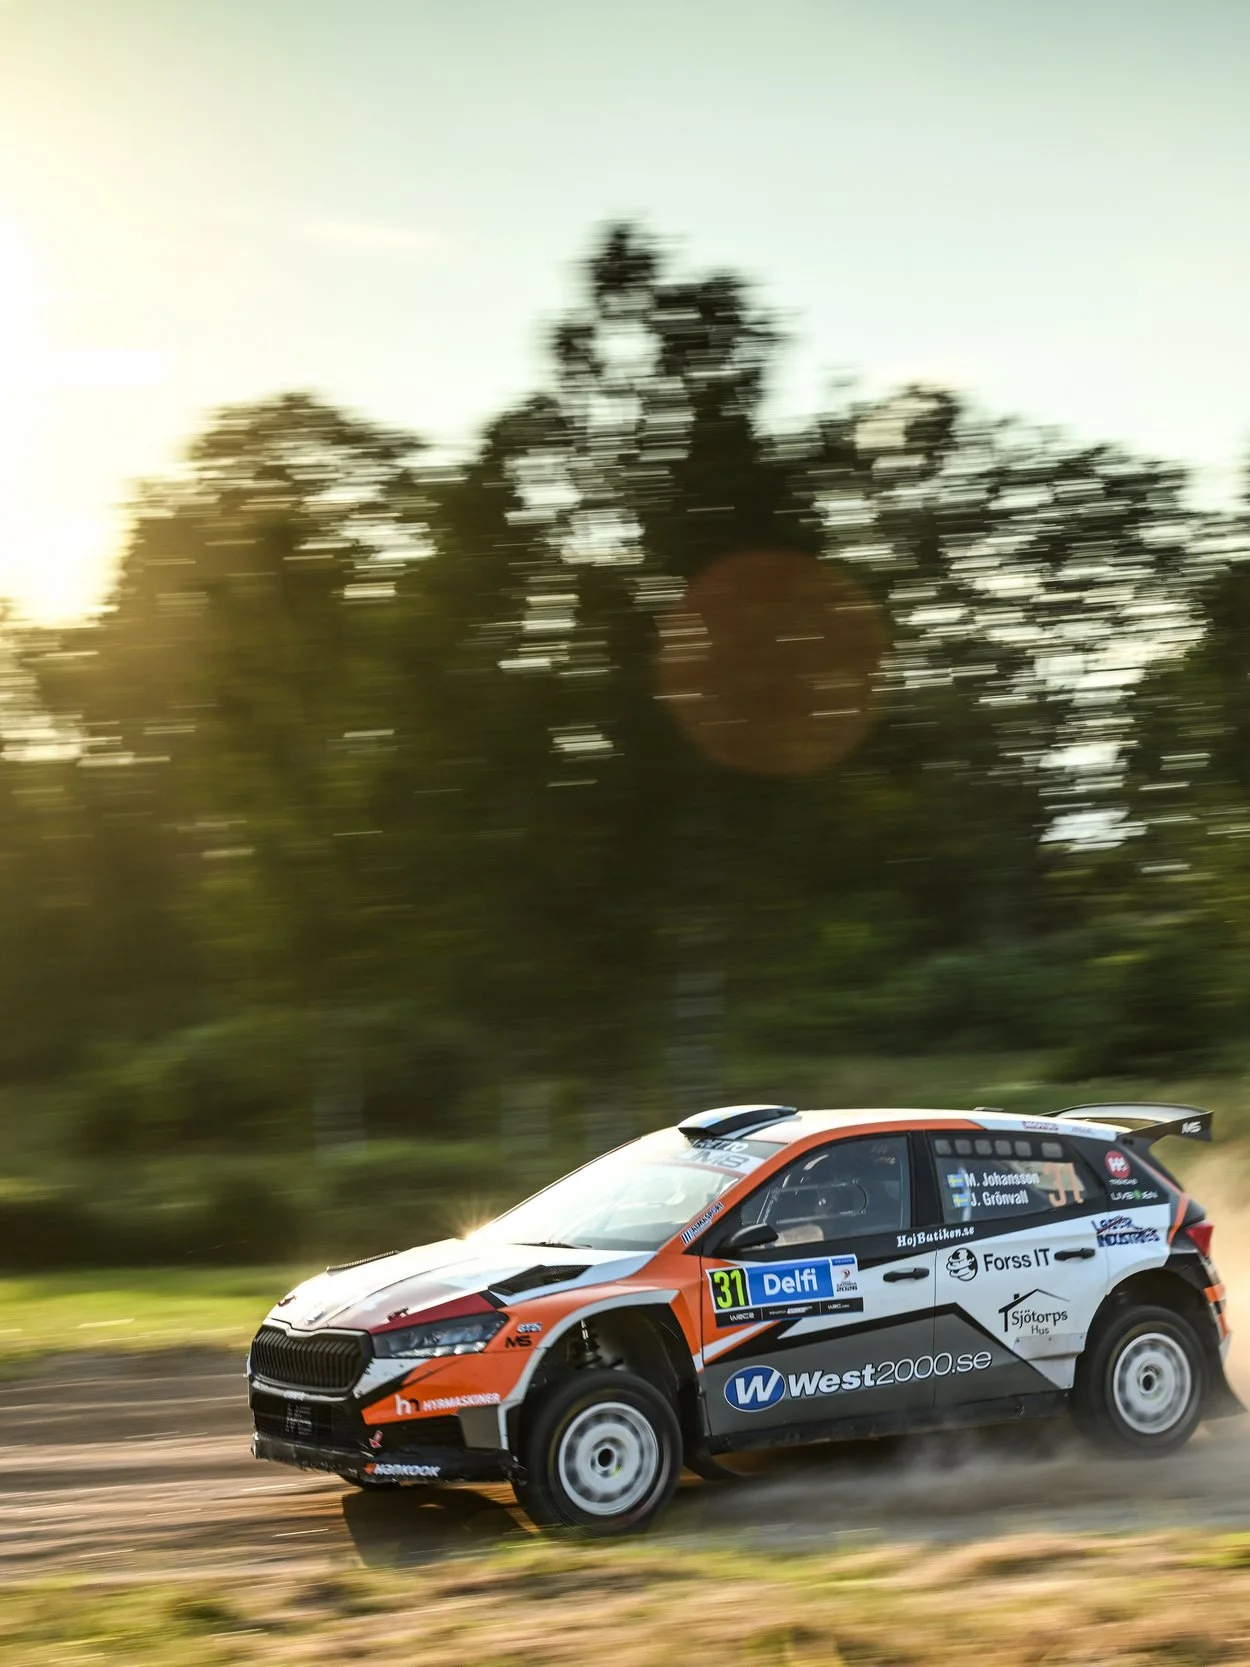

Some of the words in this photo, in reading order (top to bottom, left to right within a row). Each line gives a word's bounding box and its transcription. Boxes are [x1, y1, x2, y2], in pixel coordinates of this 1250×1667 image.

[964, 1173, 980, 1188] M.
[982, 1171, 1040, 1187] Johansson
[1043, 1161, 1085, 1207] 31
[970, 1194, 981, 1207] J.
[982, 1189, 1029, 1206] Grönvall
[896, 1226, 975, 1248] HojButiken.se
[983, 1251, 1032, 1273] Forss
[1033, 1248, 1051, 1266] IT
[714, 1268, 746, 1309] 31
[763, 1267, 819, 1296] Delfi
[1011, 1309, 1069, 1328] Sjötorps
[1031, 1325, 1050, 1335] Hus
[504, 1335, 533, 1348] MS
[734, 1369, 780, 1405] W
[787, 1350, 992, 1397] West2000.se
[423, 1392, 501, 1412] HYRMASKINER
